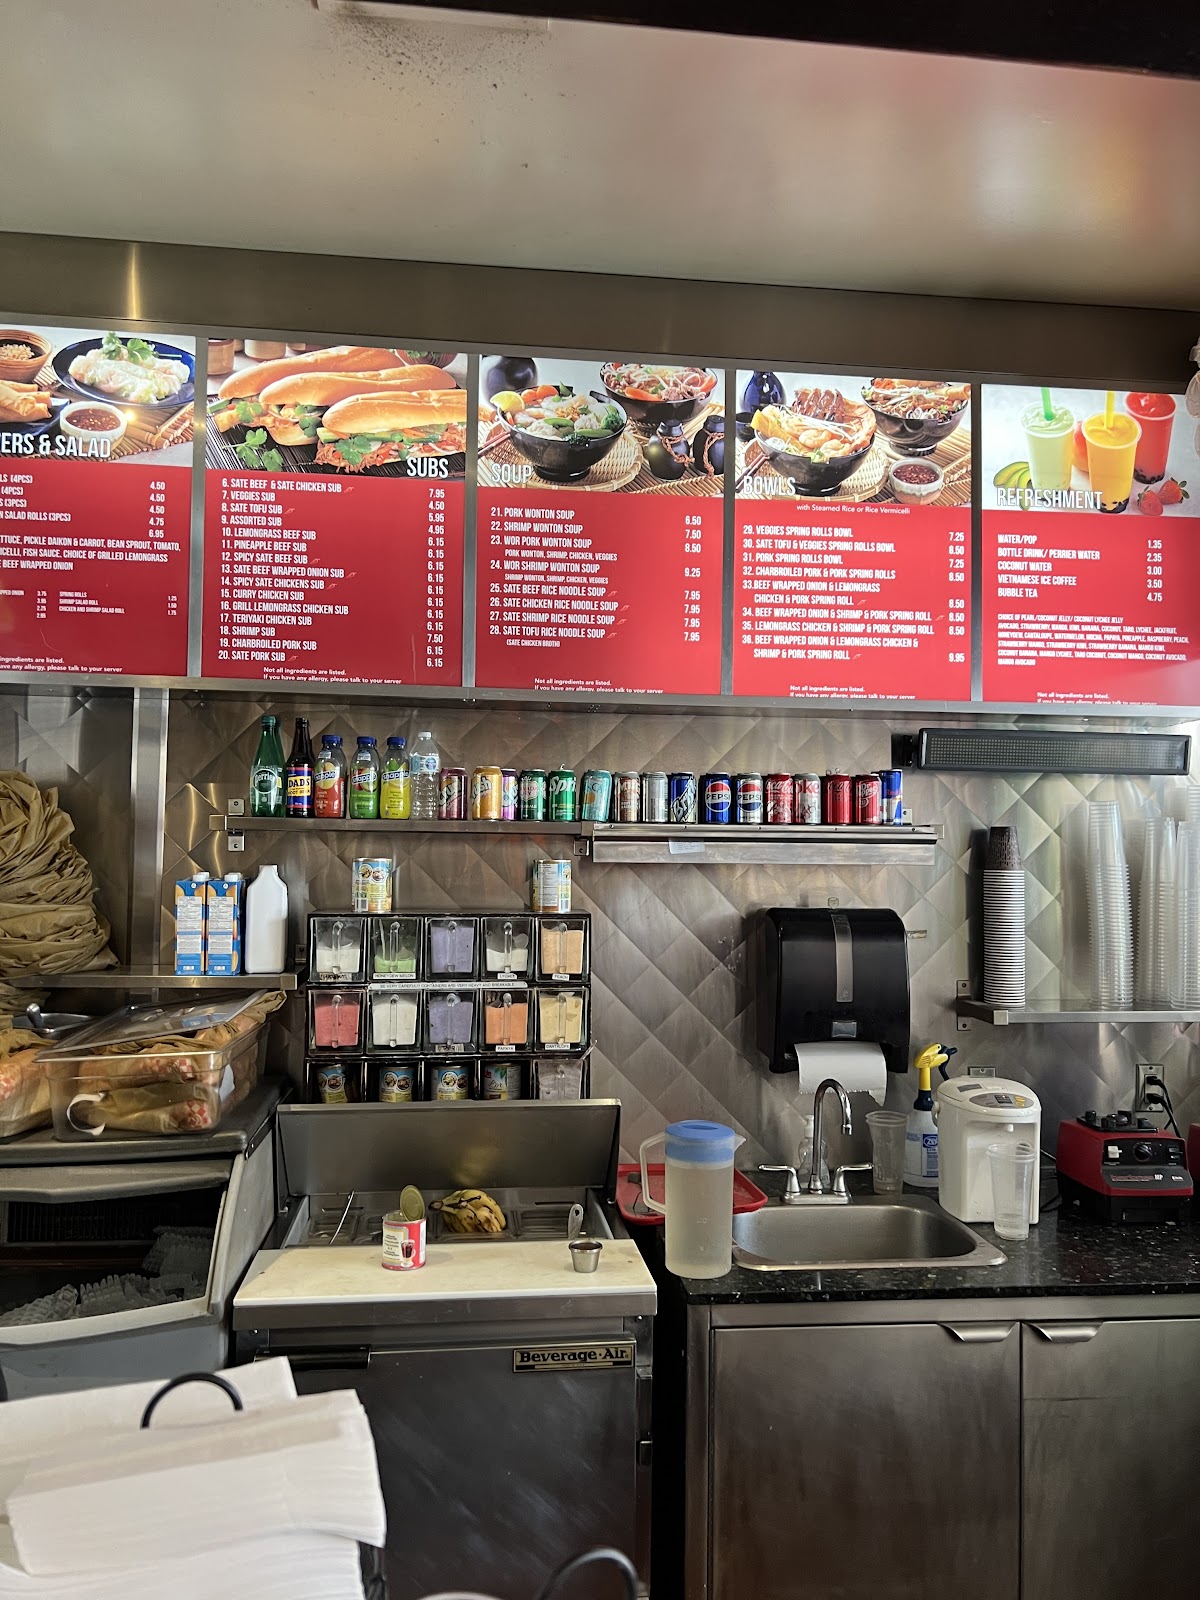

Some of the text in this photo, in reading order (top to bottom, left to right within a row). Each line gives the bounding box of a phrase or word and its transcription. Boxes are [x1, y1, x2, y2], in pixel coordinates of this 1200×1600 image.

[0, 432, 111, 458] ERS & SALAD
[406, 456, 449, 479] SUBS
[491, 463, 532, 484] SOUP
[222, 477, 444, 498] 6. SATE BEEF & SATE CHICKEN SUB 7.95
[743, 475, 796, 496] BOWLS
[222, 490, 444, 510] 7. VEGGIES SUB 4.50
[997, 487, 1103, 510] REFRESHMENT
[4, 510, 164, 526] SALAD ROLLS (3PCS) 4.75
[221, 502, 444, 522] 8. SATE TOFU SUB 5.95
[491, 506, 701, 525] 21. PORK WONTON SOUP 6.50
[148, 529, 164, 538] 6.95
[222, 526, 444, 546] 10. LEMONGRASS BEEF SUB 6.15
[743, 524, 964, 541] 29. VEGGIES SPRING ROLLS BOWL 7.25
[23, 535, 180, 551] PICKLE DAIKON & CARROT, BEAN SPROUT, TOMATO,
[490, 534, 701, 553] 23. WOR PORK WONTON SOUP 8.50
[997, 534, 1162, 549] WATER/POP 1.35
[505, 548, 617, 561] PORK WONTON, SHRIMP, CHICKEN, VEGGIES
[742, 552, 964, 568] 31. PORK SPRING ROLLS BOWL 7.25
[997, 547, 1162, 562] BOTTLE DRINK/ PERRIER WATER 2.35
[997, 560, 1162, 575] COCONUT WATER 3.00
[221, 576, 443, 594] 14. SPICY SATE CHICKENS SUB 6.15
[997, 574, 1162, 588] VIETNAMESE ICE COFFEE 3.50
[490, 583, 700, 600] 25. SATE BEEF RICE NOODLE SOUP 7.95
[997, 587, 1162, 601] BUBBLE TEA 4.75
[220, 600, 443, 619] 16. GRILL LEMONGRASS CHICKEN SUB 6.15
[220, 613, 443, 631] 17. TERIYAKI CHICKEN SUB 6.15
[489, 611, 700, 627] 27. SATE SHRIMP RICE NOODLE SOUP 7.95
[706, 793, 731, 801] PEPSI
[738, 793, 762, 801] PEPSI
